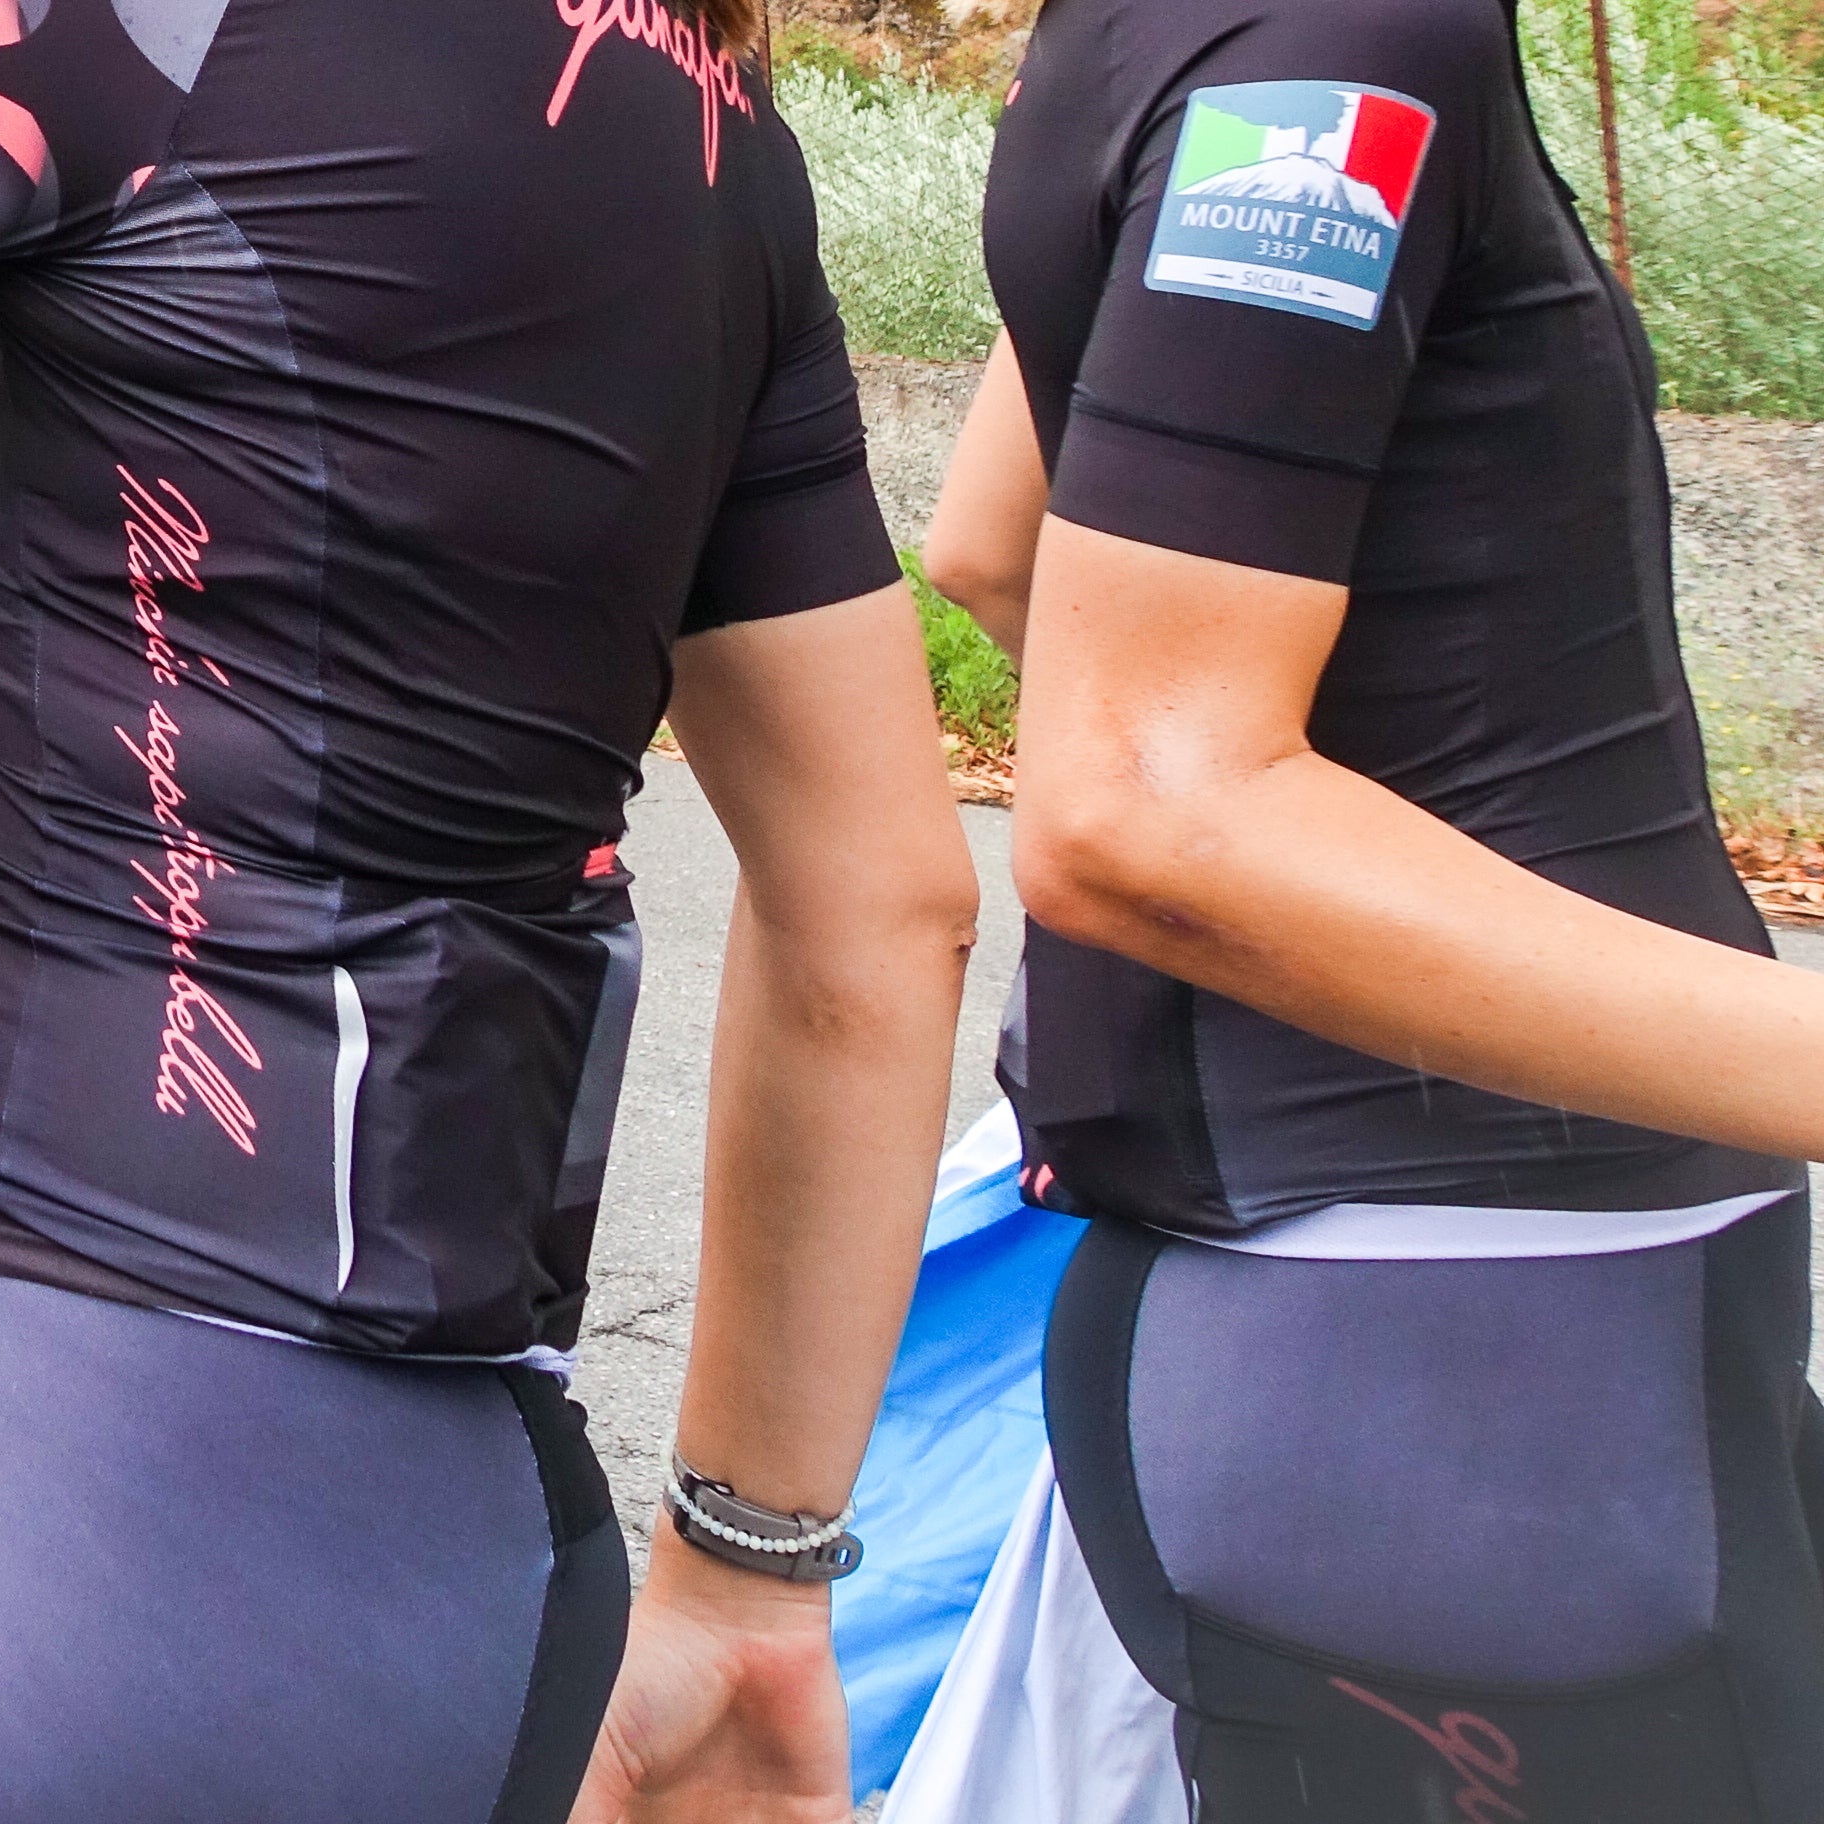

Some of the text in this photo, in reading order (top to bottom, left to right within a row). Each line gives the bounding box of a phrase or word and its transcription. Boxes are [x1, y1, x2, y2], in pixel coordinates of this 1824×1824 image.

[1180, 201, 1382, 261] MOUNT ETNA
[1254, 238, 1311, 262] 3357
[1240, 270, 1305, 297] SICILIA
[155, 964, 264, 1157] bellu
